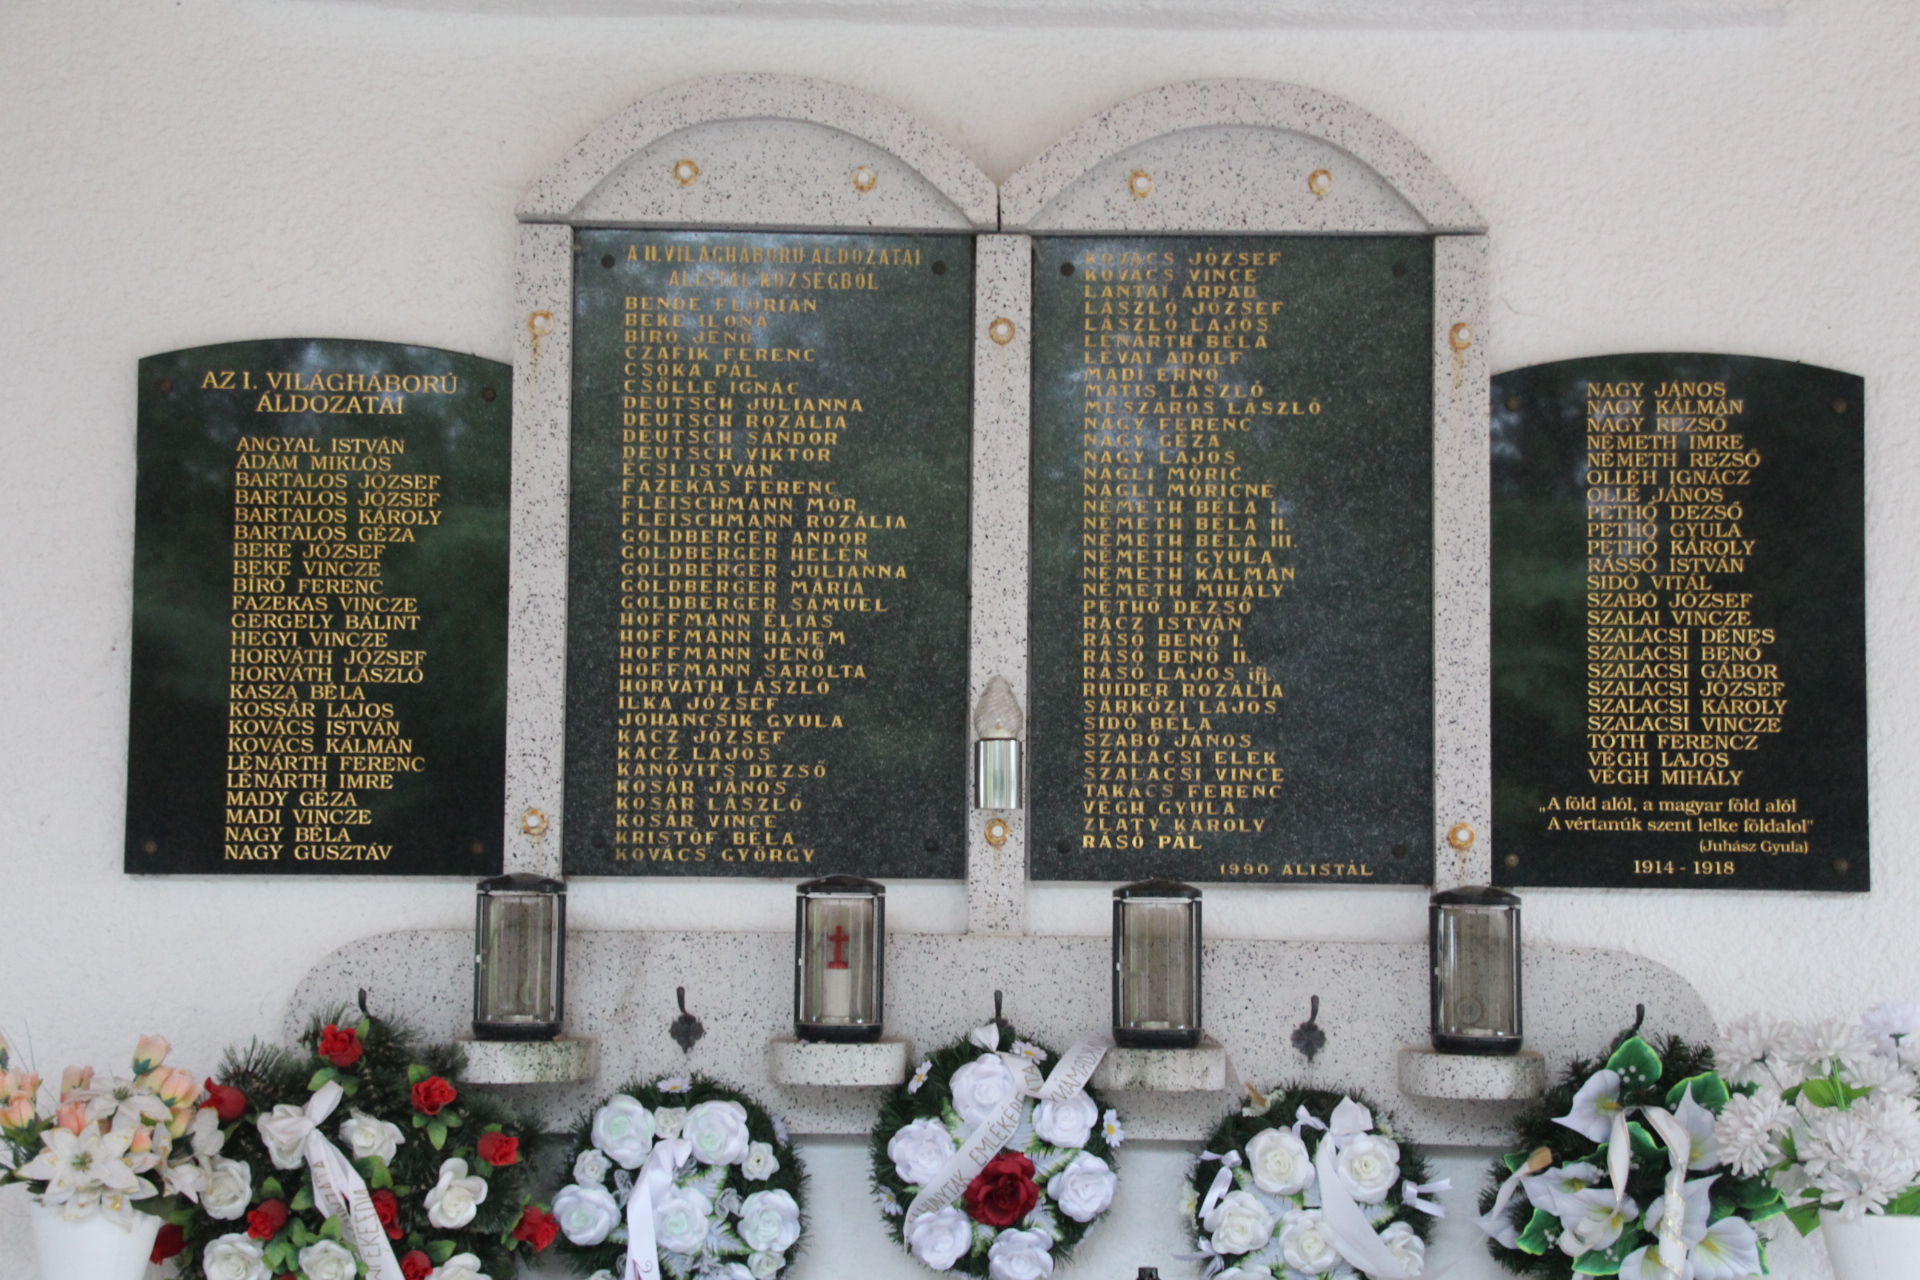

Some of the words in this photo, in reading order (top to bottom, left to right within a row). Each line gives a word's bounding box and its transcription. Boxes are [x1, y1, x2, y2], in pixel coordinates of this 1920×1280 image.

[201, 371, 236, 390] AZ
[242, 371, 258, 390] I.
[266, 370, 459, 395] VILÁGHÁBORÚ
[1587, 381, 1645, 398] NAGY
[1653, 377, 1728, 397] JÁNOS
[255, 391, 405, 415] ÁLDOZATAI
[1586, 398, 1645, 414] NAGY
[1655, 394, 1745, 415] KÁLMÁN
[235, 435, 322, 453] ANGYAL
[330, 433, 406, 454] ISTVÁN
[1586, 430, 1678, 450] NÉMETH
[1690, 433, 1744, 450] IMRE
[235, 450, 299, 470] ÁDÁM
[309, 451, 394, 472] MIKLÓS
[1587, 448, 1679, 468] NÉMETH
[1689, 448, 1763, 468] REZSŐ
[234, 471, 349, 489] BARTALOS
[357, 469, 441, 490] JÓZSEF
[1586, 465, 1659, 485] OLLÉH
[1669, 465, 1751, 485] IGNÁCZ
[1586, 483, 1641, 502] OLLÉ
[1652, 483, 1724, 503] JÁNOS
[234, 506, 349, 524] BARTALOS
[357, 505, 442, 525] KÁROLY
[232, 541, 293, 558] BEKE
[301, 539, 387, 559] JÓZSEF
[232, 559, 292, 576] BEKE
[302, 560, 382, 577] VINCZE
[1587, 553, 1659, 573] RÁSSÓ
[1669, 553, 1746, 573] ISTVÁN
[297, 577, 384, 595] FERENC
[1586, 570, 1641, 590] SIDÓ
[1651, 570, 1714, 590] VITÁL
[231, 594, 330, 612] FAZEKAS
[339, 596, 418, 613] VINCZE
[1586, 588, 1660, 608] SZABÓ
[1667, 588, 1754, 608] JÓZSEF
[229, 612, 333, 629] GERGELY
[344, 609, 422, 630] BÁLINT
[1586, 609, 1662, 626] SZALAI
[1671, 609, 1753, 626] VINCZE
[230, 629, 299, 646] HEGYI
[309, 631, 389, 648] VINCZE
[1586, 627, 1690, 644] SZALACSI
[1700, 624, 1777, 644] DÉNES
[229, 643, 334, 664] HORVÁTH
[342, 645, 425, 666] JÓZSEF
[229, 683, 300, 700] KASZA
[309, 680, 367, 700] BÉLA
[1587, 680, 1691, 696] SZALACSI
[1699, 677, 1786, 697] JÓZSEF
[228, 697, 317, 718] KOSSÁR
[326, 702, 396, 719] LAJOS
[1587, 697, 1691, 714] SZALACSI
[1701, 694, 1788, 715] KÁROLY
[227, 715, 316, 735] KOVÁCS
[325, 716, 401, 736] ISTVÁN
[1587, 729, 1647, 749] TÓTH
[1657, 733, 1760, 750] FERENCZ
[226, 750, 329, 771] LÉNÁRTH
[339, 755, 425, 772] FERENC
[1588, 764, 1651, 784] VÉGH
[1661, 766, 1744, 786] MIHÁLY
[225, 790, 288, 807] MADY
[297, 787, 359, 807] GÉZA
[1565, 796, 1597, 812] föld
[1601, 797, 1637, 813] alól,
[1642, 800, 1654, 812] a
[1658, 799, 1723, 816] magyar
[1728, 798, 1760, 813] föld
[1765, 798, 1798, 813] alól
[225, 808, 282, 824] MADI
[292, 808, 373, 825] VINCZE
[1547, 817, 1561, 831] A
[1565, 816, 1643, 832] vértanúk
[1647, 819, 1693, 832] szent
[1698, 817, 1738, 833] lelke
[223, 843, 283, 859] NAGY
[292, 840, 393, 861] GUSZTÁV
[1699, 839, 1757, 854] (Juhász
[1760, 840, 1810, 856] Gyula)
[1219, 863, 1270, 876] 1990
[1281, 859, 1375, 876] ALISTÁL
[1633, 859, 1675, 875] 1914
[1692, 860, 1736, 876] 1918
